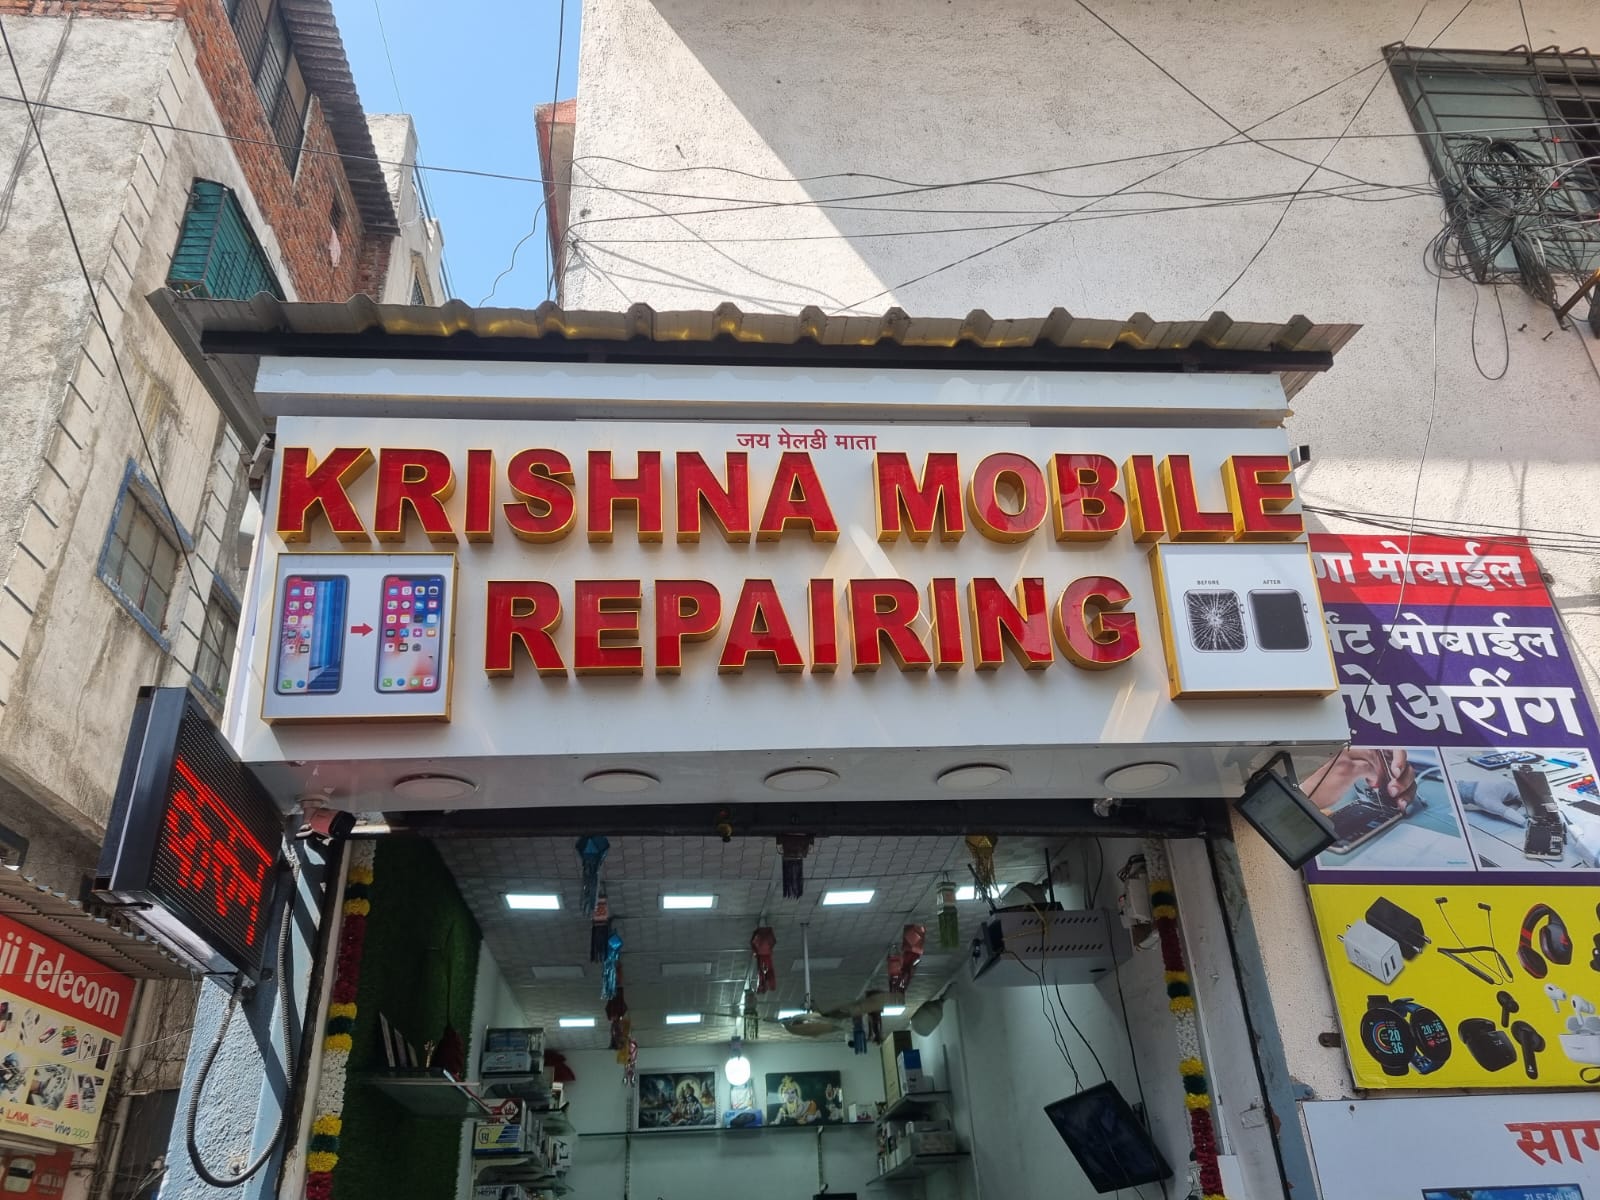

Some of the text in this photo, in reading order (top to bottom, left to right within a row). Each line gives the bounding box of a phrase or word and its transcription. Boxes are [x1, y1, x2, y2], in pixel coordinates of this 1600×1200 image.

[736, 428, 877, 450] जय मेलडी माता
[276, 447, 1304, 543] KRISHNA MOBILE
[1362, 541, 1527, 592] मोबाईल
[484, 575, 1142, 677] REPAIRING
[1382, 612, 1559, 662] मोबाईल
[1340, 663, 1585, 737] पेअरींग
[24, 942, 120, 1019] Telecom
[1388, 1029, 1401, 1042] 20
[1391, 1042, 1404, 1054] 36
[54, 1121, 72, 1136] vivo
